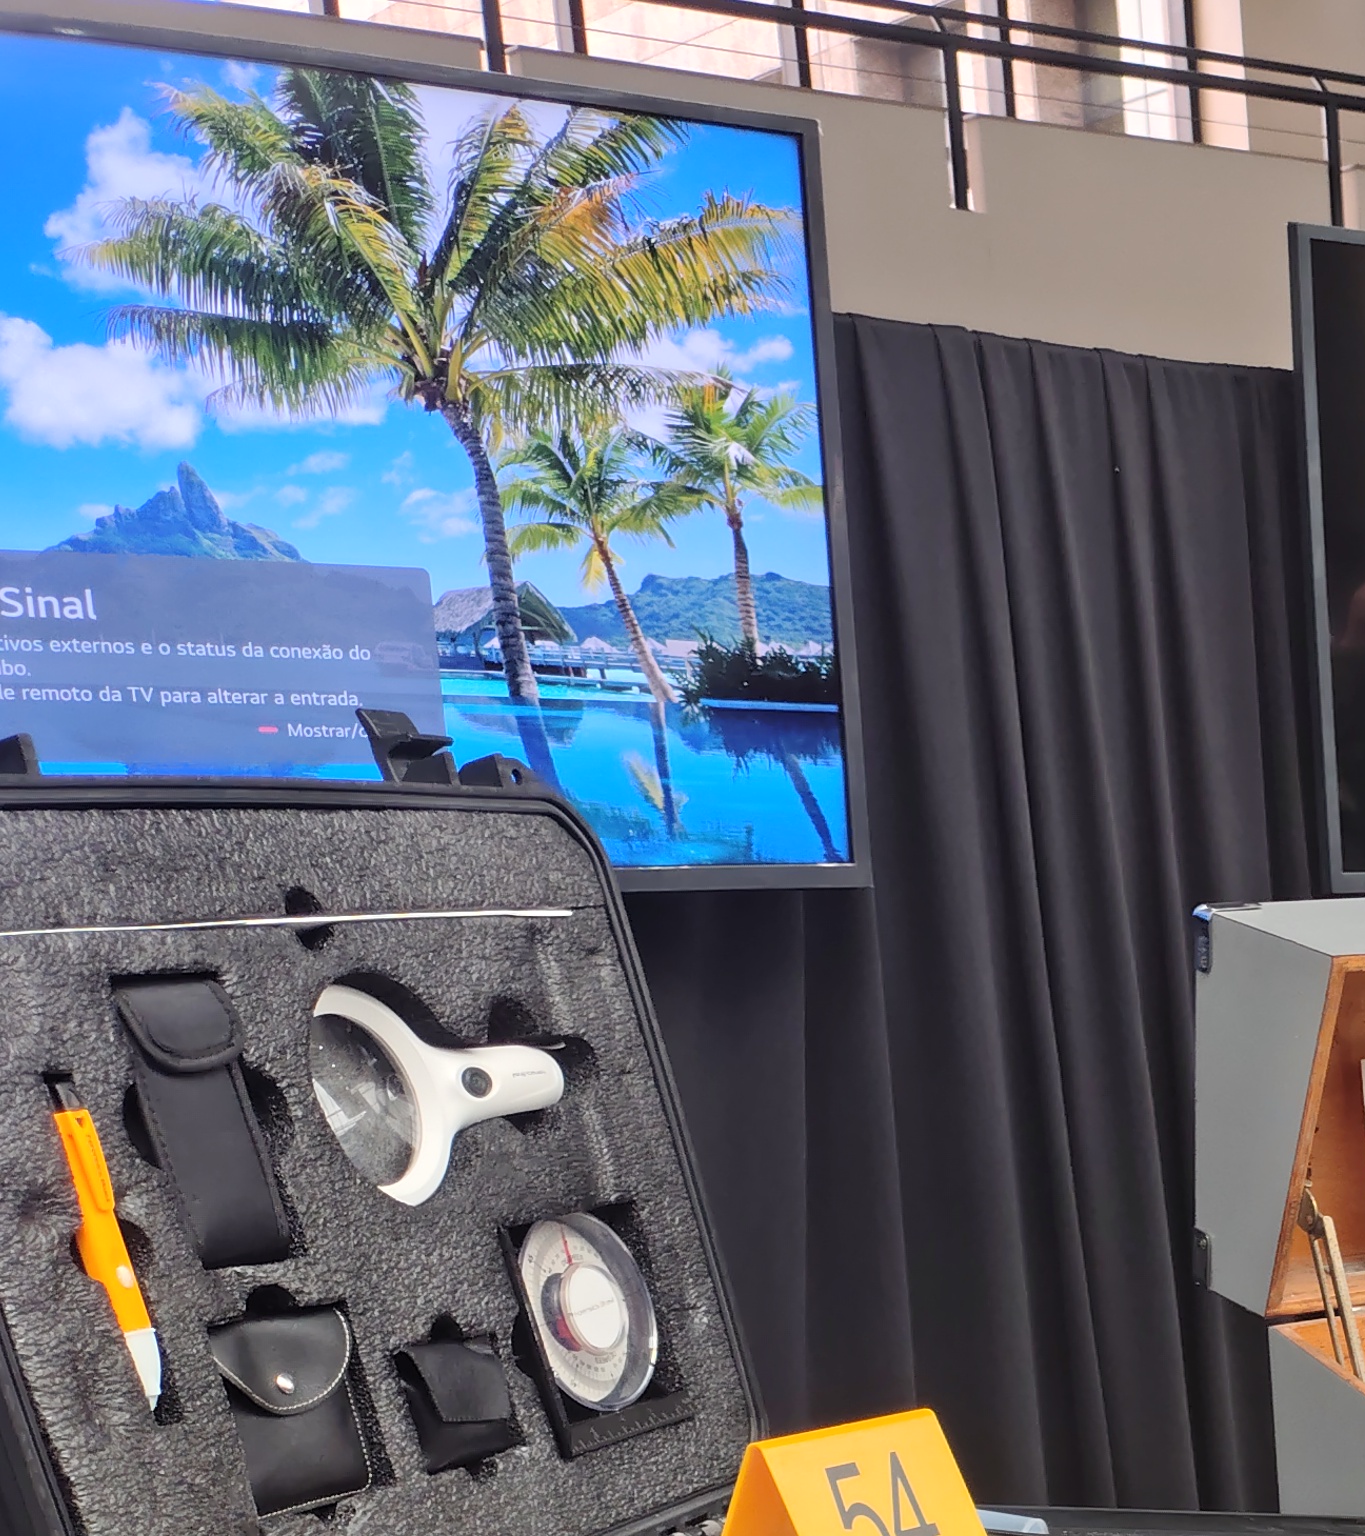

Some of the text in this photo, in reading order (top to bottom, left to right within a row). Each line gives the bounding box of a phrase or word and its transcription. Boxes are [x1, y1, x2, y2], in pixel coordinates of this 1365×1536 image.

[0, 587, 97, 620] Sinal
[50, 638, 135, 654] externos
[141, 642, 152, 655] e
[158, 642, 171, 655] o
[177, 641, 236, 658] status
[242, 642, 264, 658] da
[270, 645, 343, 660] conexão
[349, 645, 371, 661] do
[0, 659, 32, 677] bo.
[22, 687, 92, 701] remoto
[99, 686, 122, 702] da
[127, 687, 153, 702] TV
[160, 689, 201, 707] para
[207, 688, 269, 705] alterar
[274, 692, 285, 705] a
[290, 690, 364, 707] entrada.
